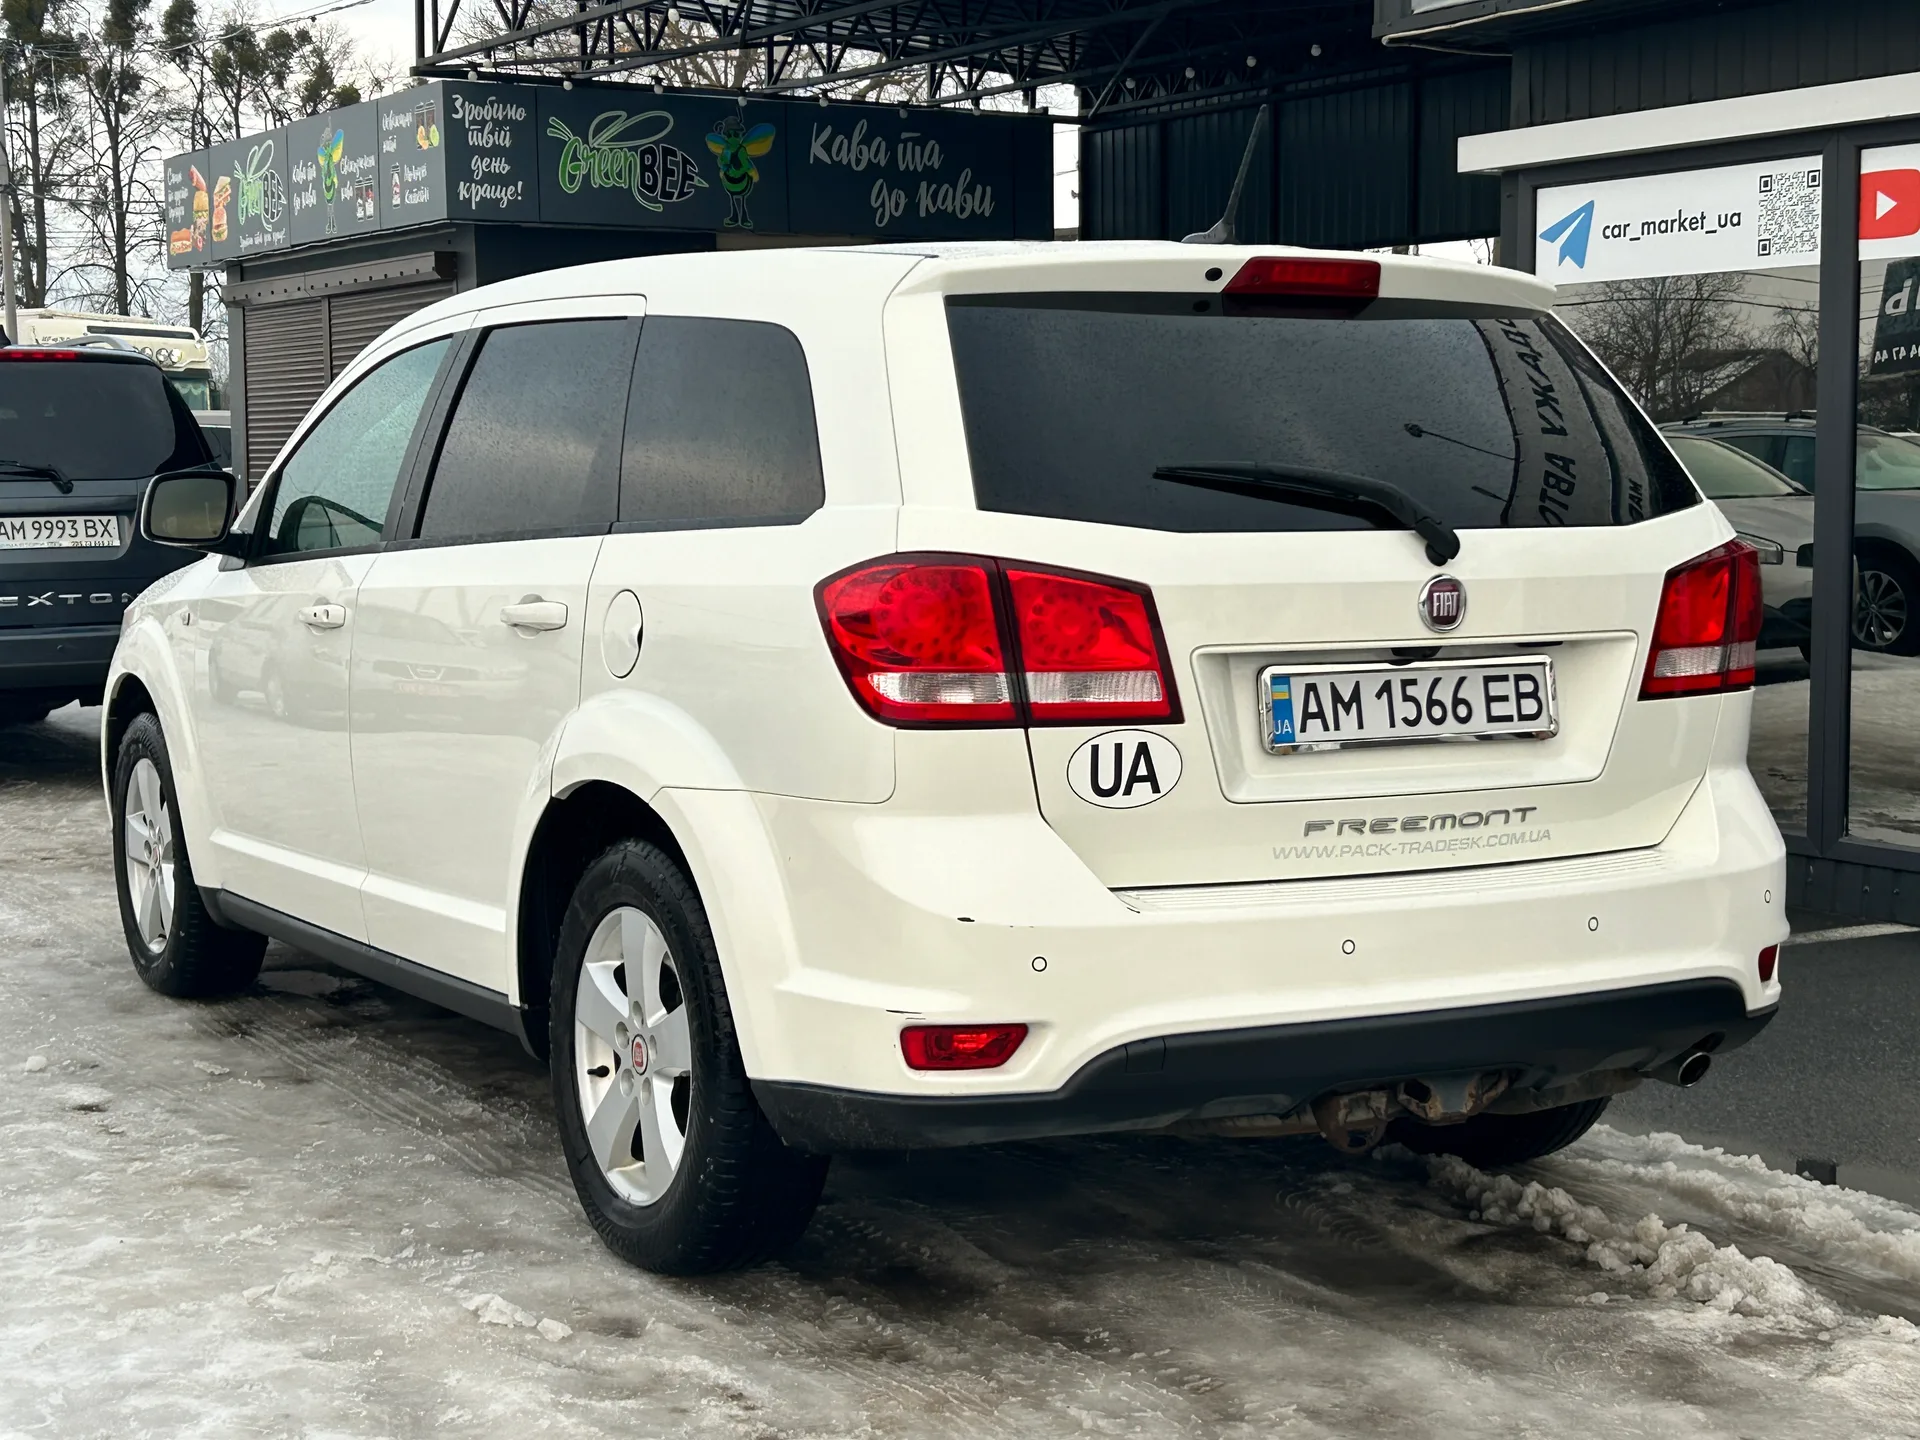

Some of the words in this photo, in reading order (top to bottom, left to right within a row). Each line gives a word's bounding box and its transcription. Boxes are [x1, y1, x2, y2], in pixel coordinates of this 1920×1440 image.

[451, 93, 526, 128] Зробимо
[468, 122, 512, 148] твій
[810, 118, 890, 172] Кава
[897, 132, 944, 172] та
[471, 154, 511, 180] день
[458, 180, 523, 210] краще!
[870, 178, 908, 228] до
[916, 168, 995, 220] кави
[1602, 208, 1742, 242] car_market_ua
[31, 519, 79, 540] 9993
[83, 518, 114, 539] BX
[1433, 591, 1459, 617] FIAT
[1300, 681, 1364, 734] AM
[1375, 676, 1472, 728] 1566
[1483, 673, 1543, 724] EB
[1090, 741, 1161, 798] UA
[1303, 806, 1537, 837] FREEMONT
[1272, 829, 1551, 860] WWW.PACK-TRADESK.COM.UA
